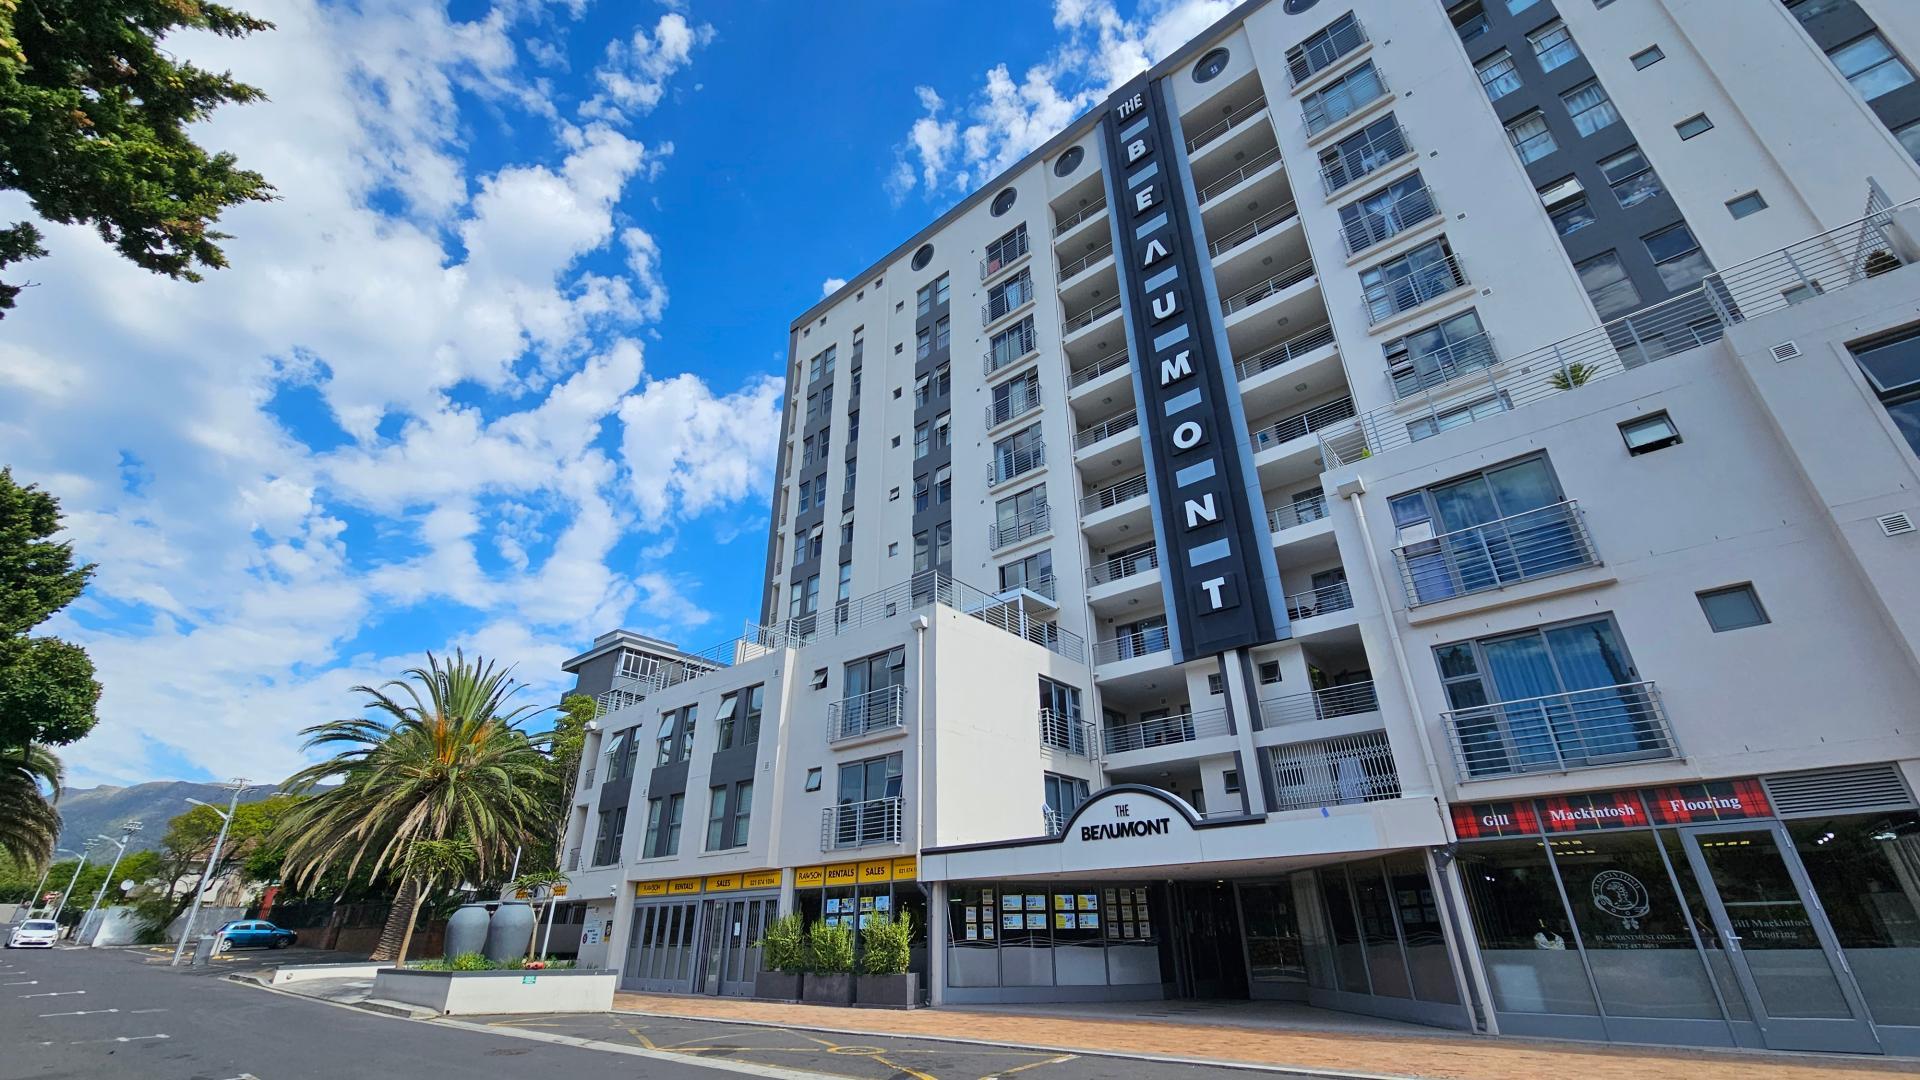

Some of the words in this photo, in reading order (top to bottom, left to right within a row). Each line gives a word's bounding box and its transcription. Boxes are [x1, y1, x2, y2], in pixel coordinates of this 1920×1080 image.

[1117, 94, 1143, 119] THE
[1127, 139, 1225, 609] BEAUMONT
[1115, 804, 1130, 817] THE
[1482, 814, 1509, 826] Gill
[1550, 804, 1635, 822] Mackintosh
[1670, 796, 1742, 812] Flooring
[1081, 818, 1170, 841] BEAUMONT
[674, 881, 694, 890] RENTALS
[716, 879, 731, 887] SALES
[799, 871, 822, 880] RAWSON
[828, 868, 855, 878] RENTALS
[865, 866, 885, 876] SALES
